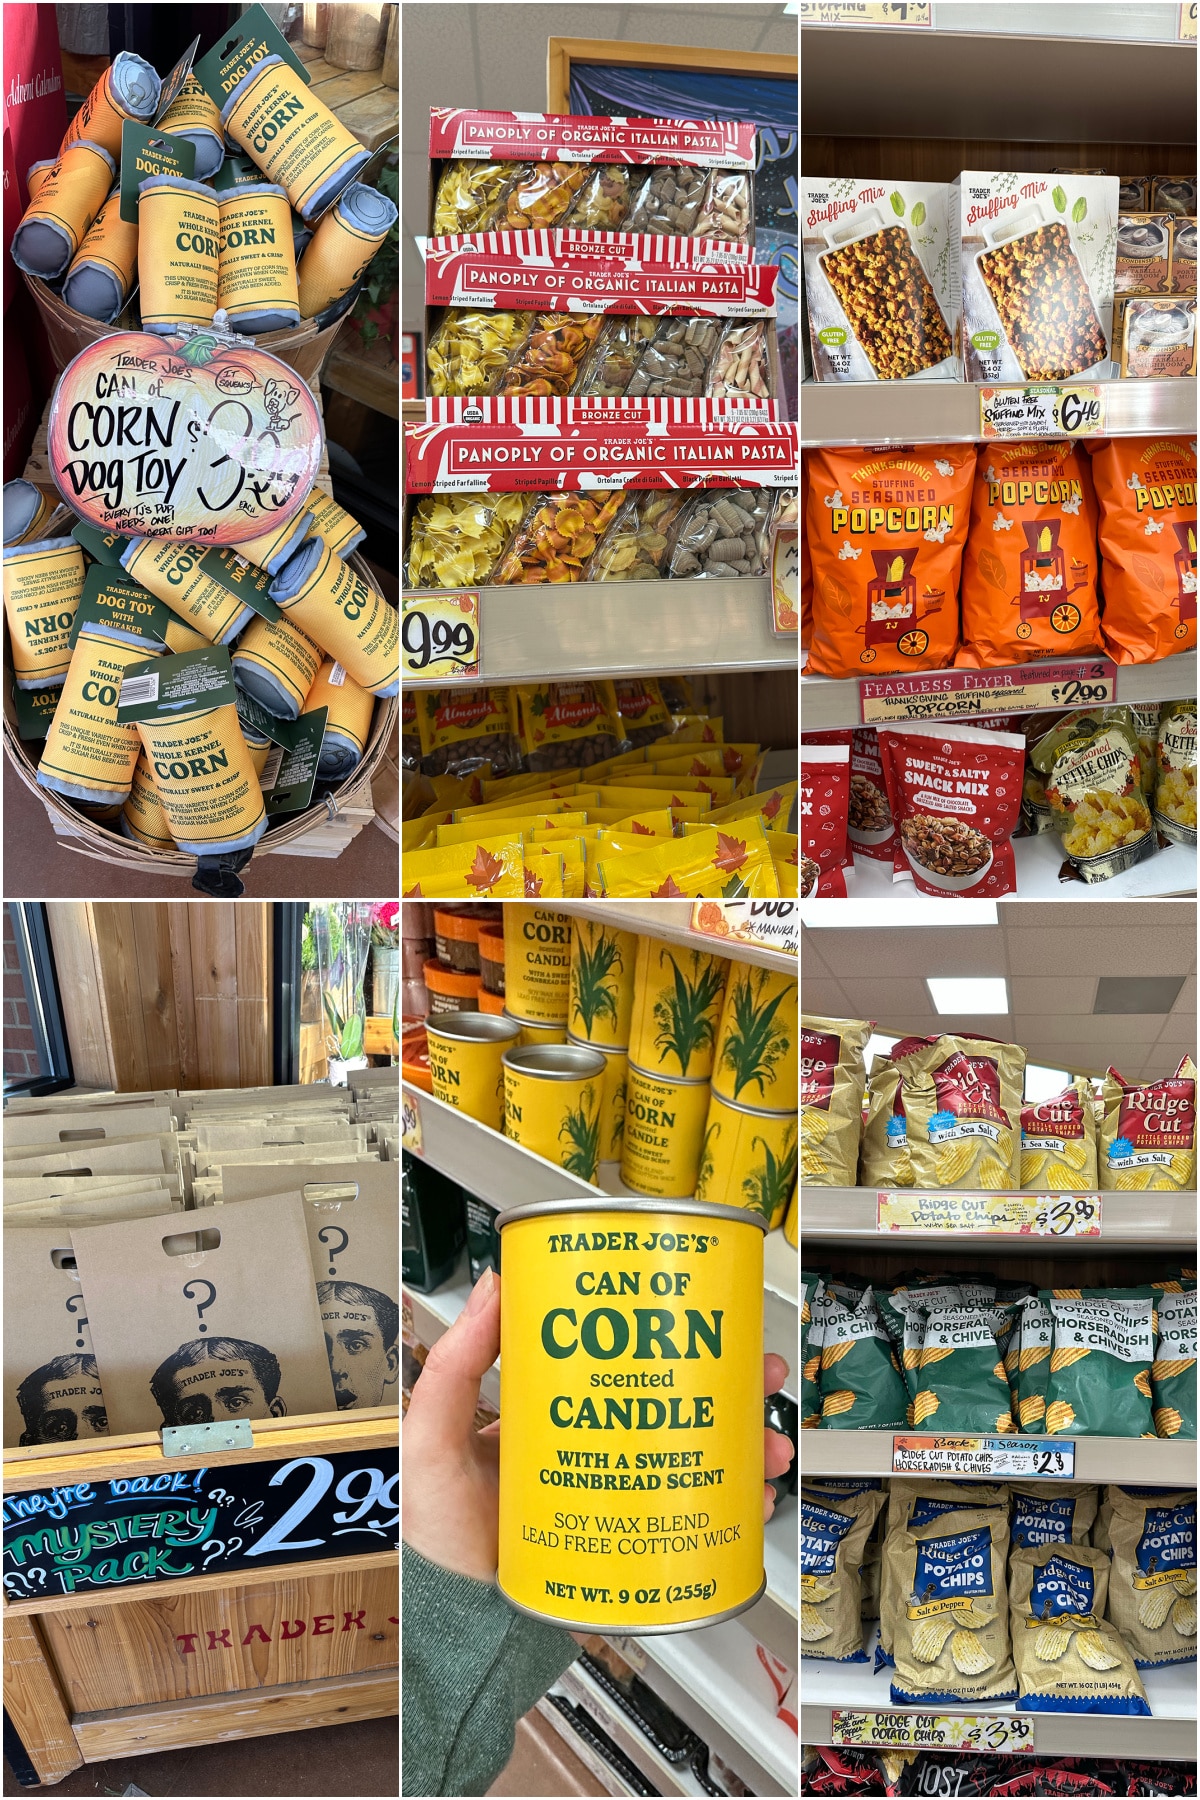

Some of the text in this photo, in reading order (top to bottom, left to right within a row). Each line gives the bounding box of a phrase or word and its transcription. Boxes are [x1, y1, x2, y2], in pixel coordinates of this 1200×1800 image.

[820, 12, 841, 22] MIX
[220, 56, 239, 76] TRADER
[221, 41, 270, 93] DOG TOY
[242, 101, 263, 128] TRADER
[246, 90, 291, 140] WHOLE KERNEL
[253, 95, 305, 153] CORN
[469, 126, 719, 148] PANOPLY OF ORGANIC ITALIAN PASTA
[807, 187, 886, 228] Stuffing Mix
[967, 181, 1048, 226] Stuffing Mix
[243, 219, 273, 227] KERNEL
[219, 229, 275, 253] CORN
[569, 244, 605, 253] BRONZE
[470, 270, 739, 294] PANOPLY OF ORGANIC ITALIAN PASTA
[111, 351, 193, 378] TRADER JOE'S
[223, 370, 238, 378] IT
[95, 372, 137, 399] CAN
[994, 396, 1019, 408] GLUTEN
[582, 411, 642, 420] BRONZE CUT
[985, 405, 1045, 422] STUFFING MIX
[68, 400, 181, 451] CORN
[459, 445, 786, 463] PANOPLY OF ORGANIC ITALIAN PASTA
[852, 460, 932, 484] THANKSGIVING
[872, 480, 915, 488] STUFFING
[989, 479, 1083, 506] POPCORN
[852, 489, 935, 503] SEASONED
[116, 518, 145, 530] NEEDS
[832, 504, 955, 533] POPCORN
[176, 526, 195, 535] GIFT
[198, 524, 217, 539] TOO!
[106, 586, 131, 597] TRADER
[96, 593, 156, 615] DOG TOY
[112, 611, 134, 622] WITH
[885, 621, 899, 629] TJ
[864, 675, 1015, 697] FEARLESS FLYER
[882, 690, 990, 705] THANKSGIVING STUFFING
[906, 699, 981, 715] POPCORN
[440, 706, 496, 722] Almonds
[551, 704, 601, 721] Almonds
[151, 740, 222, 760] WHOLE KERNEL
[152, 738, 183, 748] TRADER
[154, 749, 230, 781] CORN
[905, 757, 991, 780] SWEET & SALTY
[1055, 763, 1098, 786] KETTLE
[1097, 747, 1128, 770] CHIPS
[193, 772, 240, 793] SWEET CRISP
[904, 771, 989, 796] SNACK MIX
[1126, 1092, 1189, 1113] Ridge
[628, 1099, 676, 1129] CORN
[1144, 1113, 1181, 1133] Cut
[628, 1125, 669, 1148] CANDLE
[1117, 1154, 1166, 1167] with Sea Salt
[547, 1232, 643, 1253] TRADER
[576, 1272, 691, 1296] CAN OF
[1055, 1305, 1149, 1328] POTATO CHIPS
[541, 1308, 724, 1360] CORN
[1056, 1318, 1149, 1346] HORSERADISH
[1073, 1332, 1131, 1358] & CHIVES
[181, 1371, 216, 1388] TRADER
[590, 1368, 675, 1388] scented
[549, 1396, 715, 1430] CANDLE
[556, 1450, 704, 1470] WITH A SWEET
[895, 1461, 952, 1471] HORSERADISH
[963, 1463, 991, 1472] CHIVES
[901, 1450, 927, 1460] RIDGE
[929, 1451, 944, 1460] CUT
[947, 1452, 974, 1461] POTATO
[975, 1453, 994, 1463] CHIPS
[108, 1468, 208, 1499] back!
[539, 1468, 725, 1491] CORNBREAD SCENT
[554, 1511, 710, 1534] SOY WAX BLEND
[1016, 1516, 1066, 1531] POTATO
[522, 1524, 742, 1555] LEAD FREE COTTON WICK
[924, 1555, 984, 1576] POTATO
[940, 1572, 985, 1588] CHIPS
[545, 1578, 718, 1605] NET WT. 9 OZ (255g)
[916, 1600, 965, 1617] Salt Pepper
